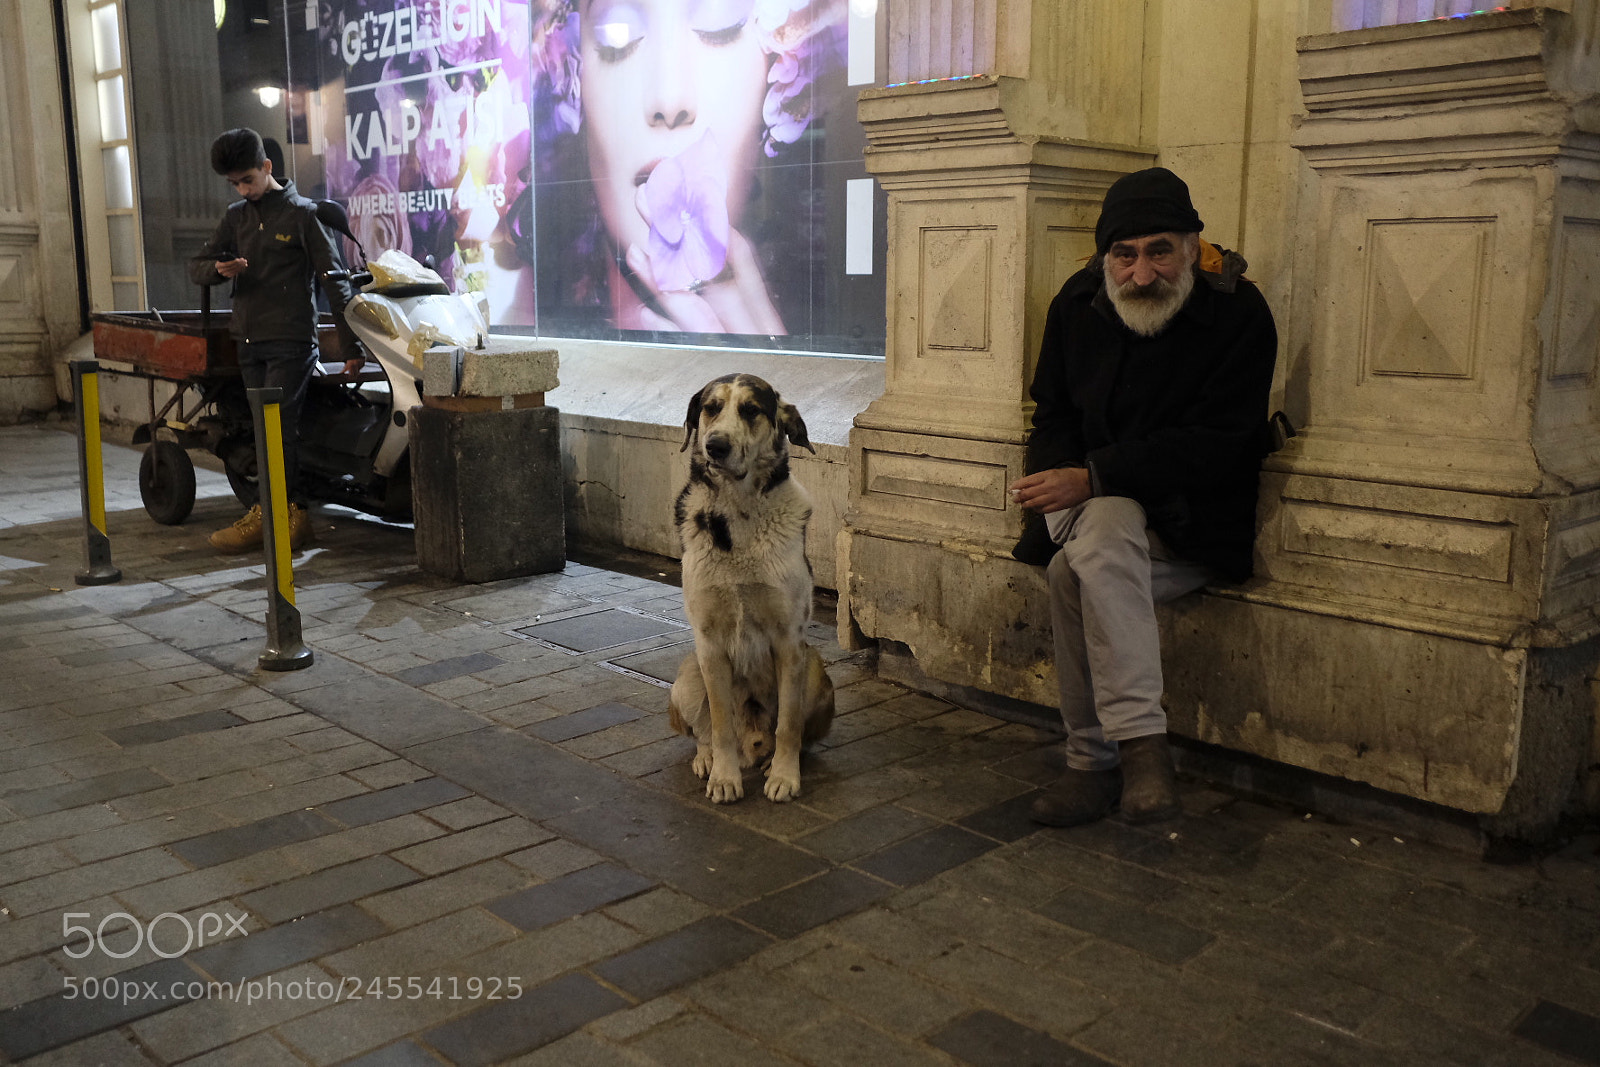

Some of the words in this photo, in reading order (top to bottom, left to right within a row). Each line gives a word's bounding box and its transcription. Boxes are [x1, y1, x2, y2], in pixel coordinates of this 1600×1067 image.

[345, 105, 421, 161] KALP
[348, 193, 395, 216] WHERE
[399, 187, 454, 213] BEAUTY
